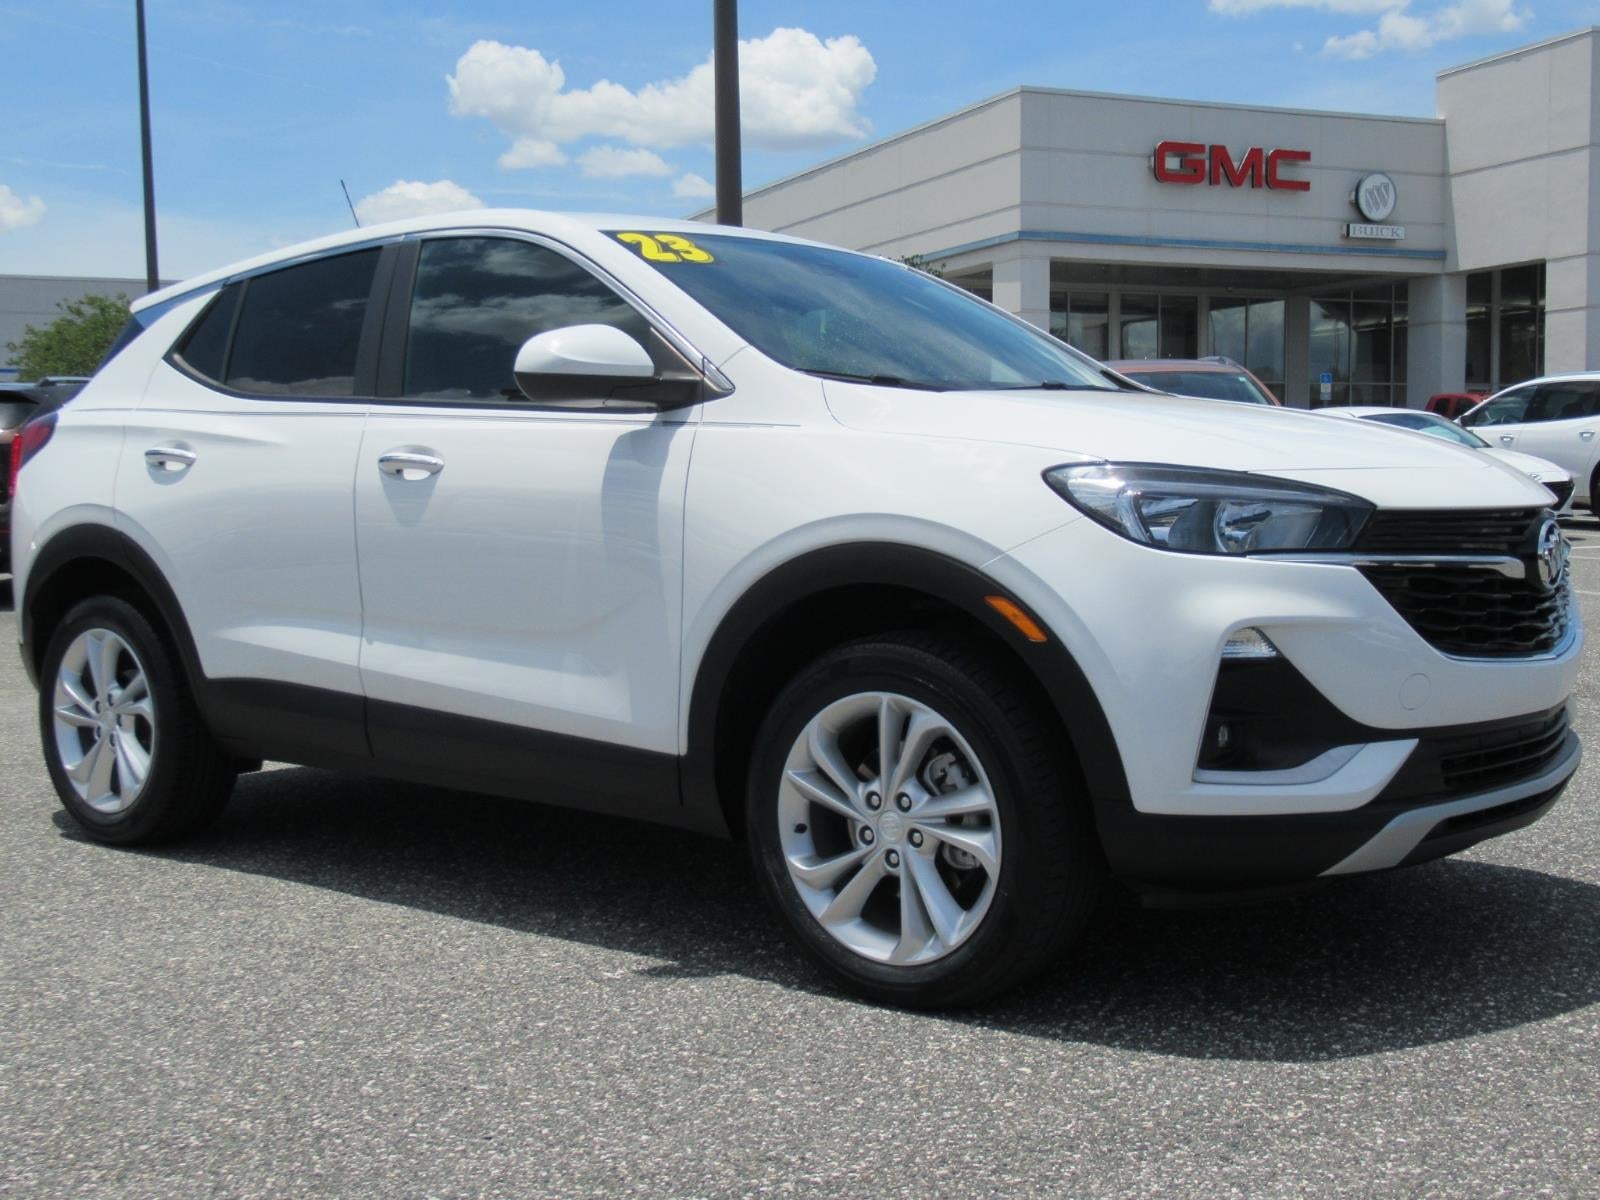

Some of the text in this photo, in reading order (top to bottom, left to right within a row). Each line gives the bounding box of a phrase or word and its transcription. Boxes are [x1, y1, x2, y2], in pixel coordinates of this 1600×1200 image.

[1155, 141, 1311, 191] GMC
[1351, 225, 1402, 238] BUICK
[617, 232, 714, 263] 23
